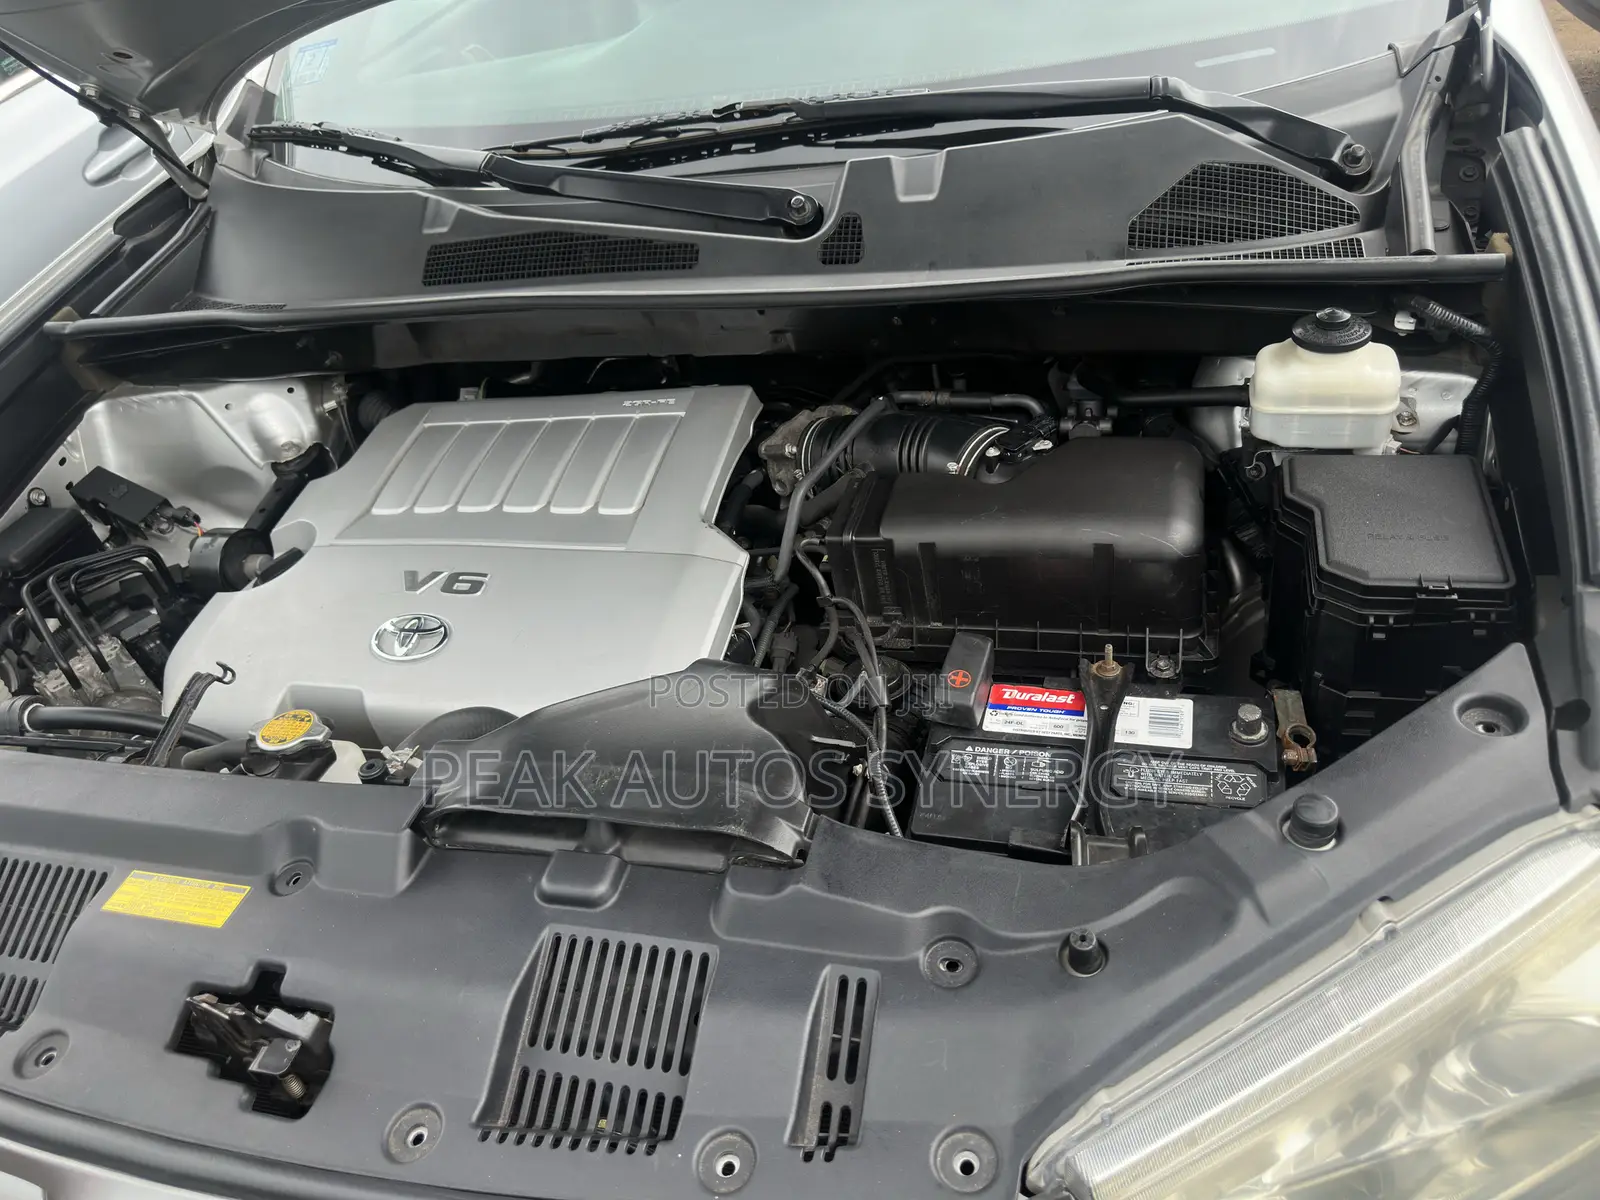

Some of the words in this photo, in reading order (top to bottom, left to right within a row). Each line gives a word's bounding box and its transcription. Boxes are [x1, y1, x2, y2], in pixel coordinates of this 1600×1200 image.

[403, 570, 491, 596] V6
[1001, 688, 1075, 704] Duralast
[974, 746, 1010, 755] DANGER
[1019, 749, 1053, 758] POISON
